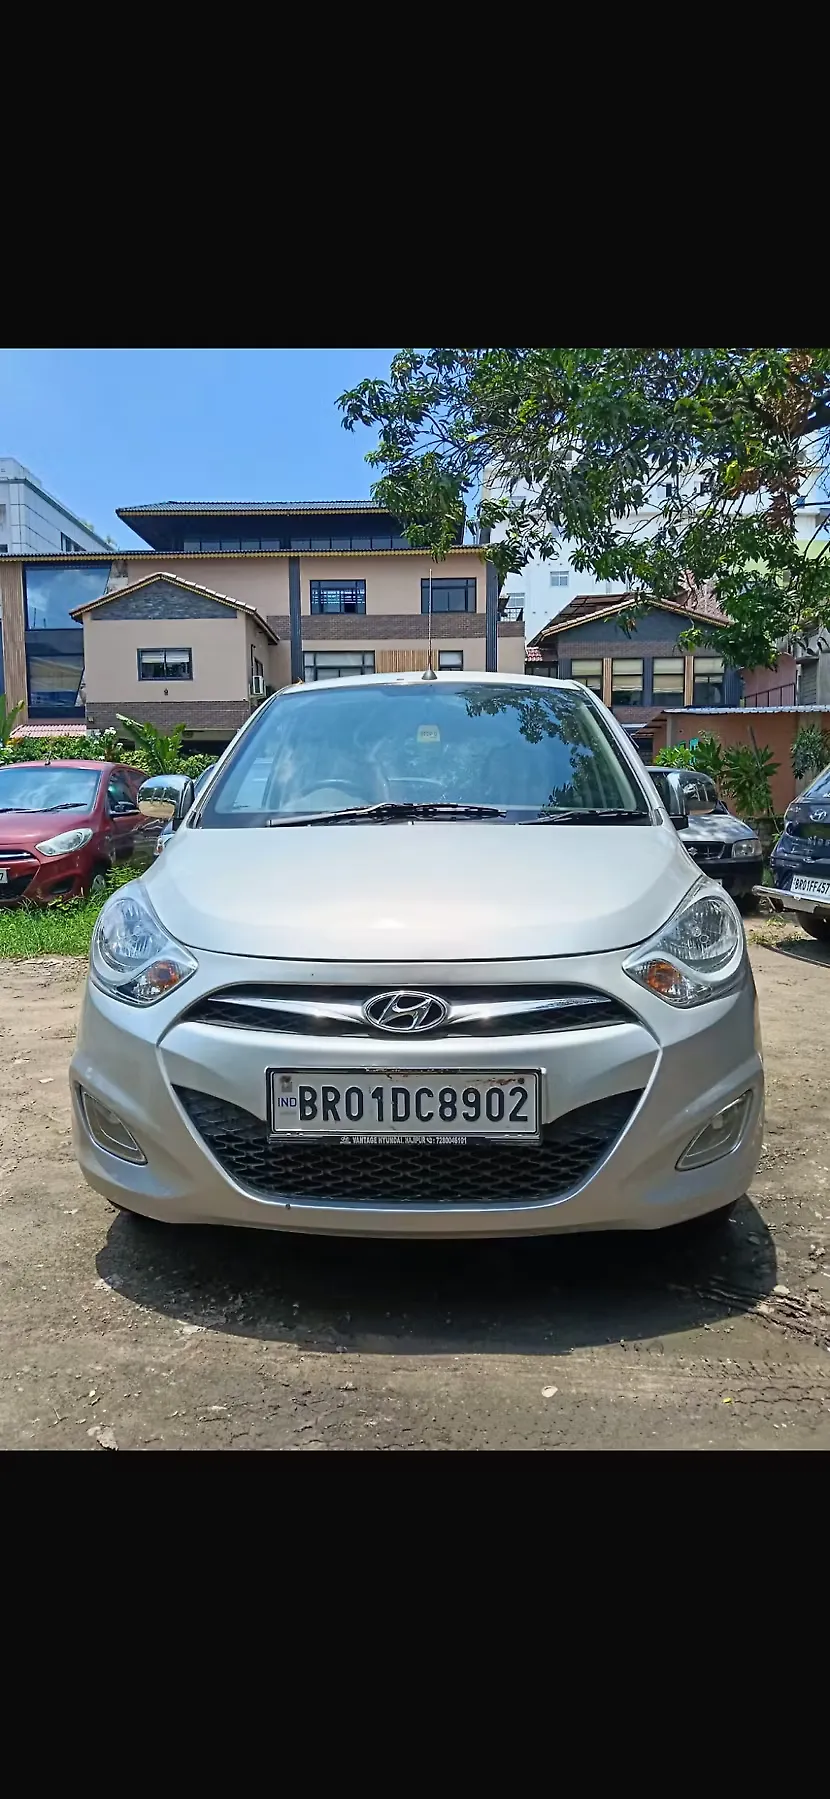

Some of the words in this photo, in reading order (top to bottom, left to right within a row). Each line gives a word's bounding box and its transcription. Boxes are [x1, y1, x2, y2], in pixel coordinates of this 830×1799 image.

[795, 878, 830, 895] BR01FF457
[277, 1097, 297, 1107] IND
[299, 1085, 528, 1122] BR01DC8902
[352, 1136, 377, 1144] VANTAGE
